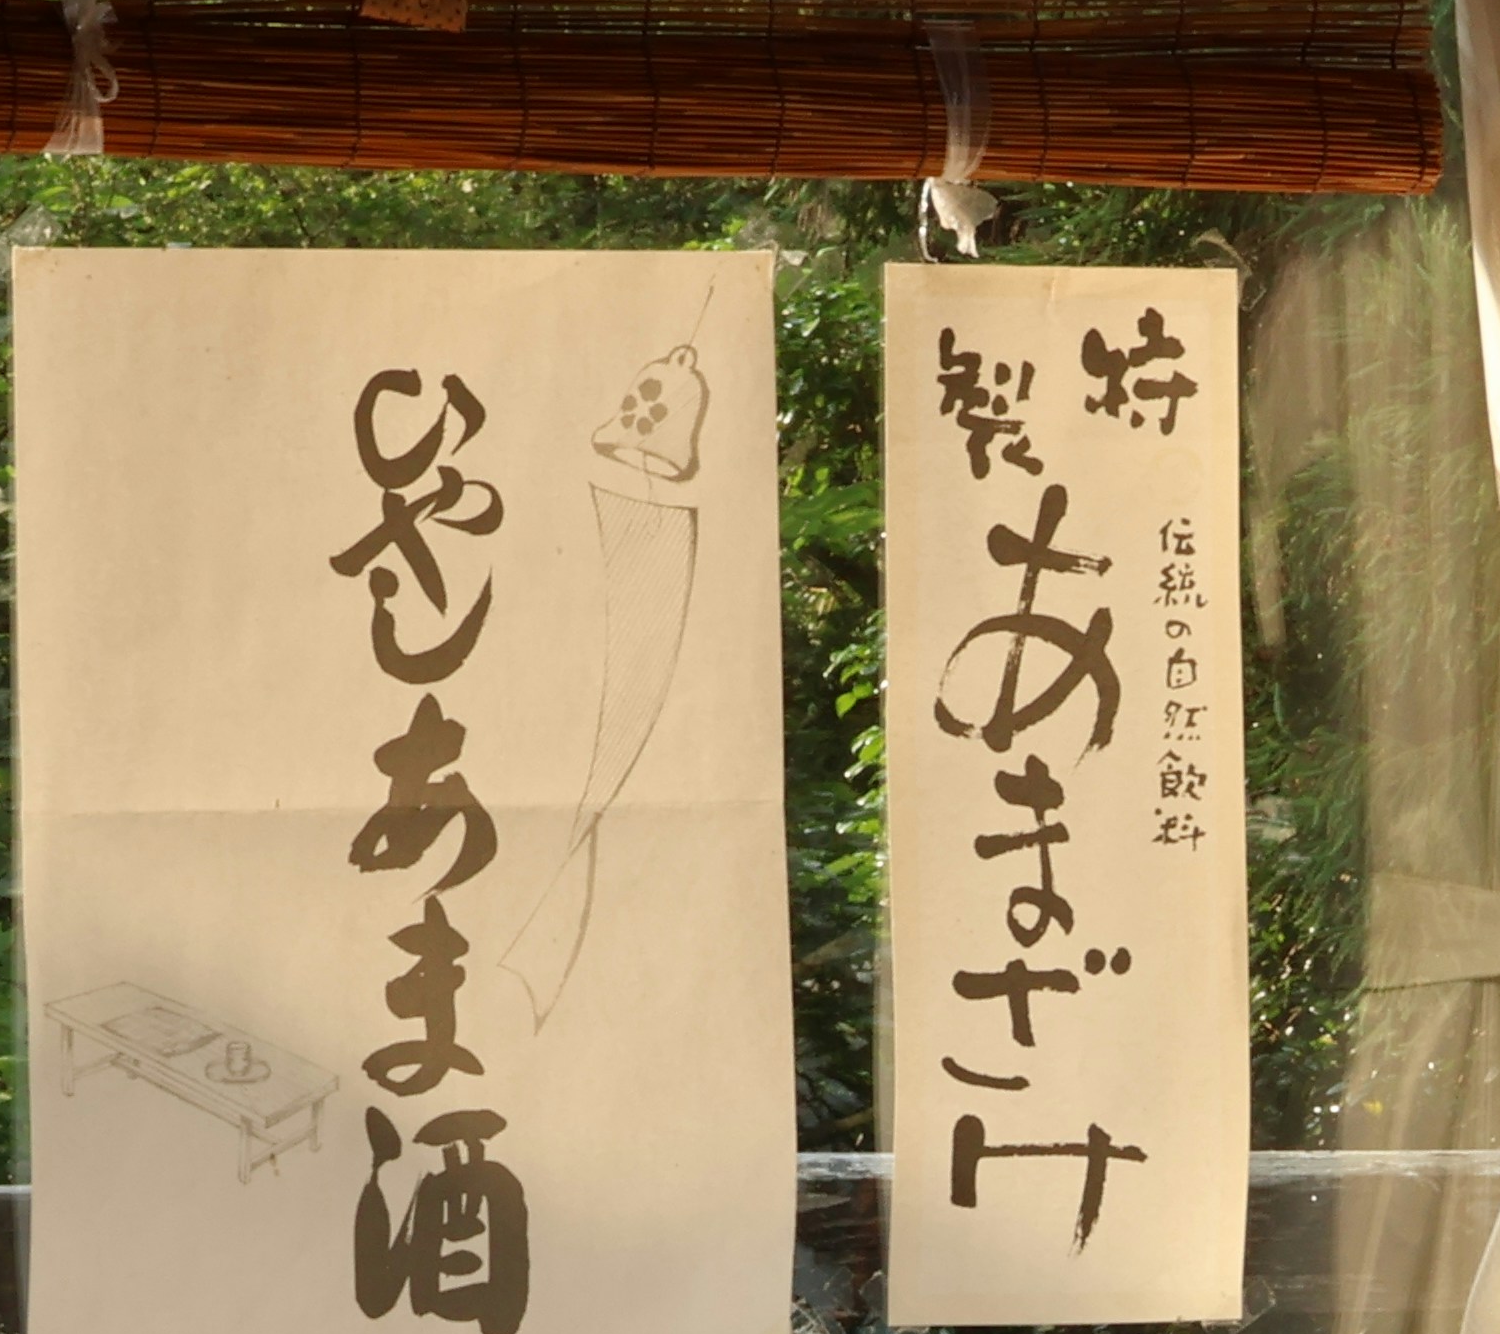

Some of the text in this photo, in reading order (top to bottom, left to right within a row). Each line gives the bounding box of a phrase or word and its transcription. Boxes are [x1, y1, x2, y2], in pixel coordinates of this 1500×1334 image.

[933, 483, 1148, 1255] あまざけ
[1151, 517, 1209, 853] 伝統の自然飲料
